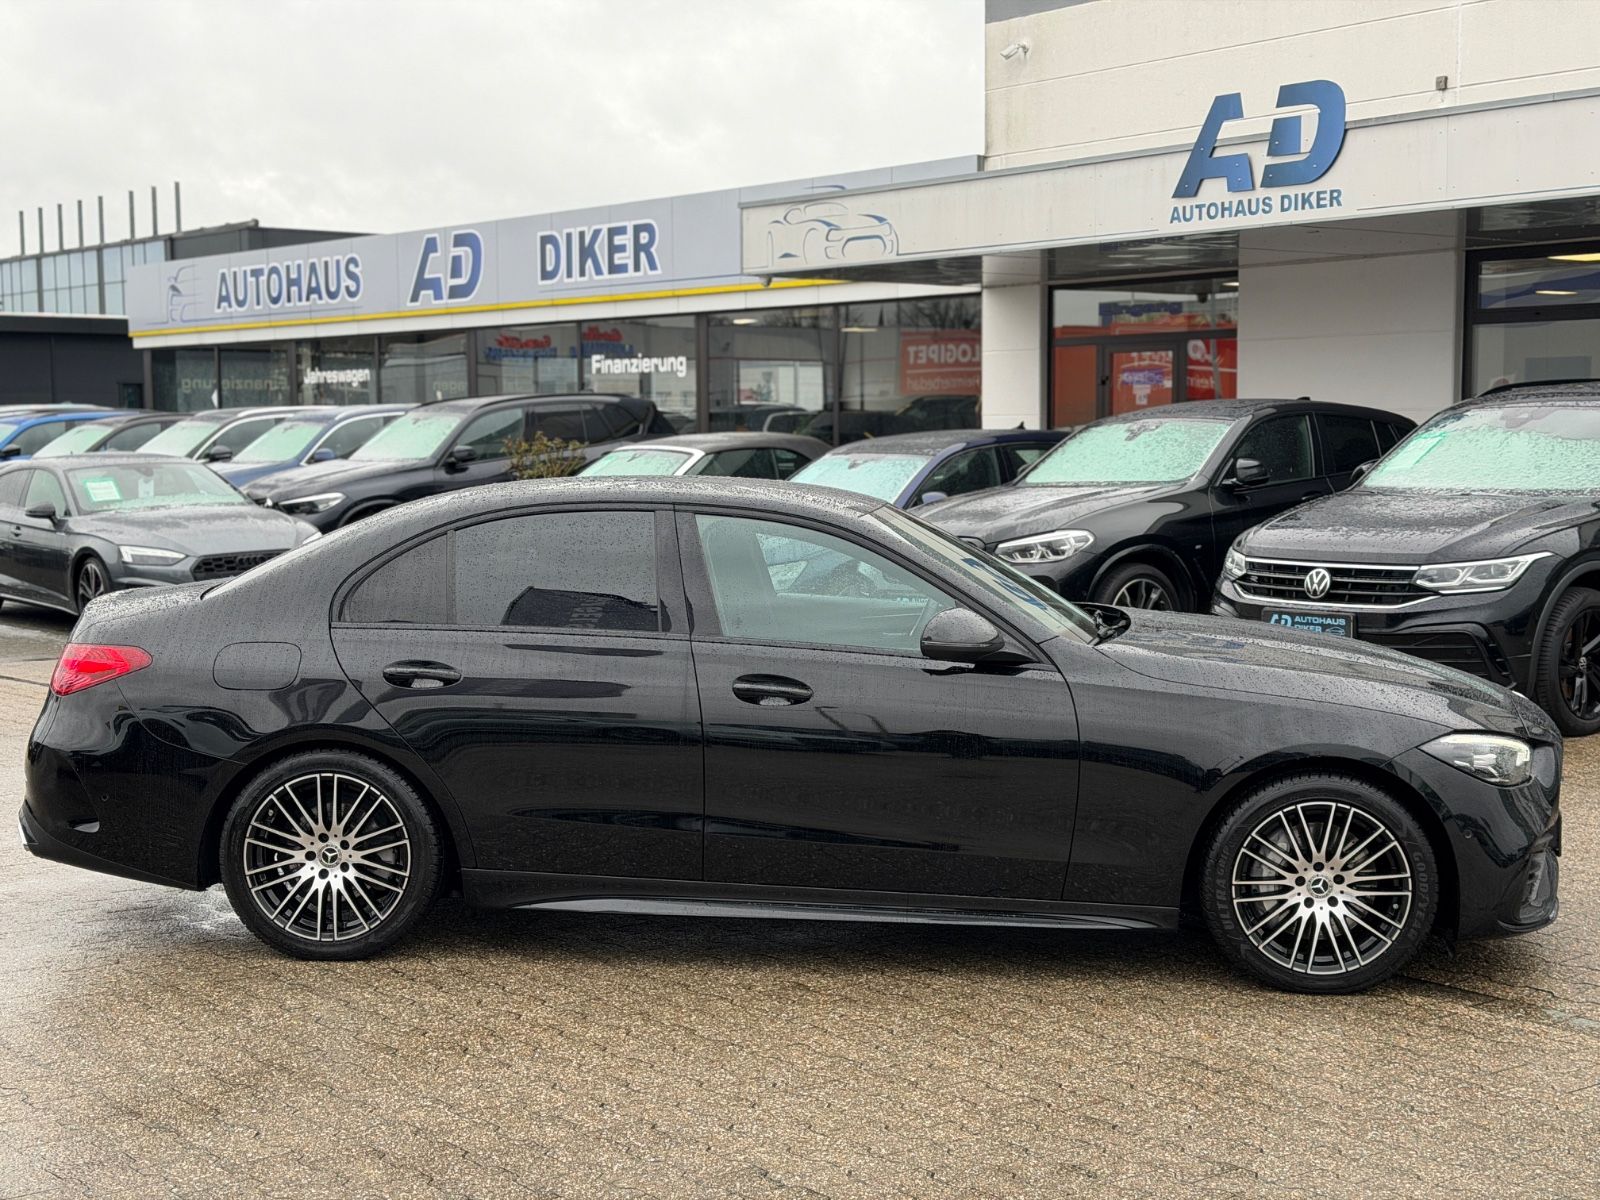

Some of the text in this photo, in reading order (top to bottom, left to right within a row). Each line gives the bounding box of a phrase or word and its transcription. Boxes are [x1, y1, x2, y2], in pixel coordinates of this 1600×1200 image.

[1171, 79, 1346, 198] AD
[1169, 188, 1343, 224] AUTOHAUS DIKER
[215, 219, 662, 312] AUTOHAUS AD DIKER
[303, 367, 371, 387] Jahreswagen
[591, 353, 687, 378] Finanzierung
[1294, 616, 1346, 626] AUTOHAUS
